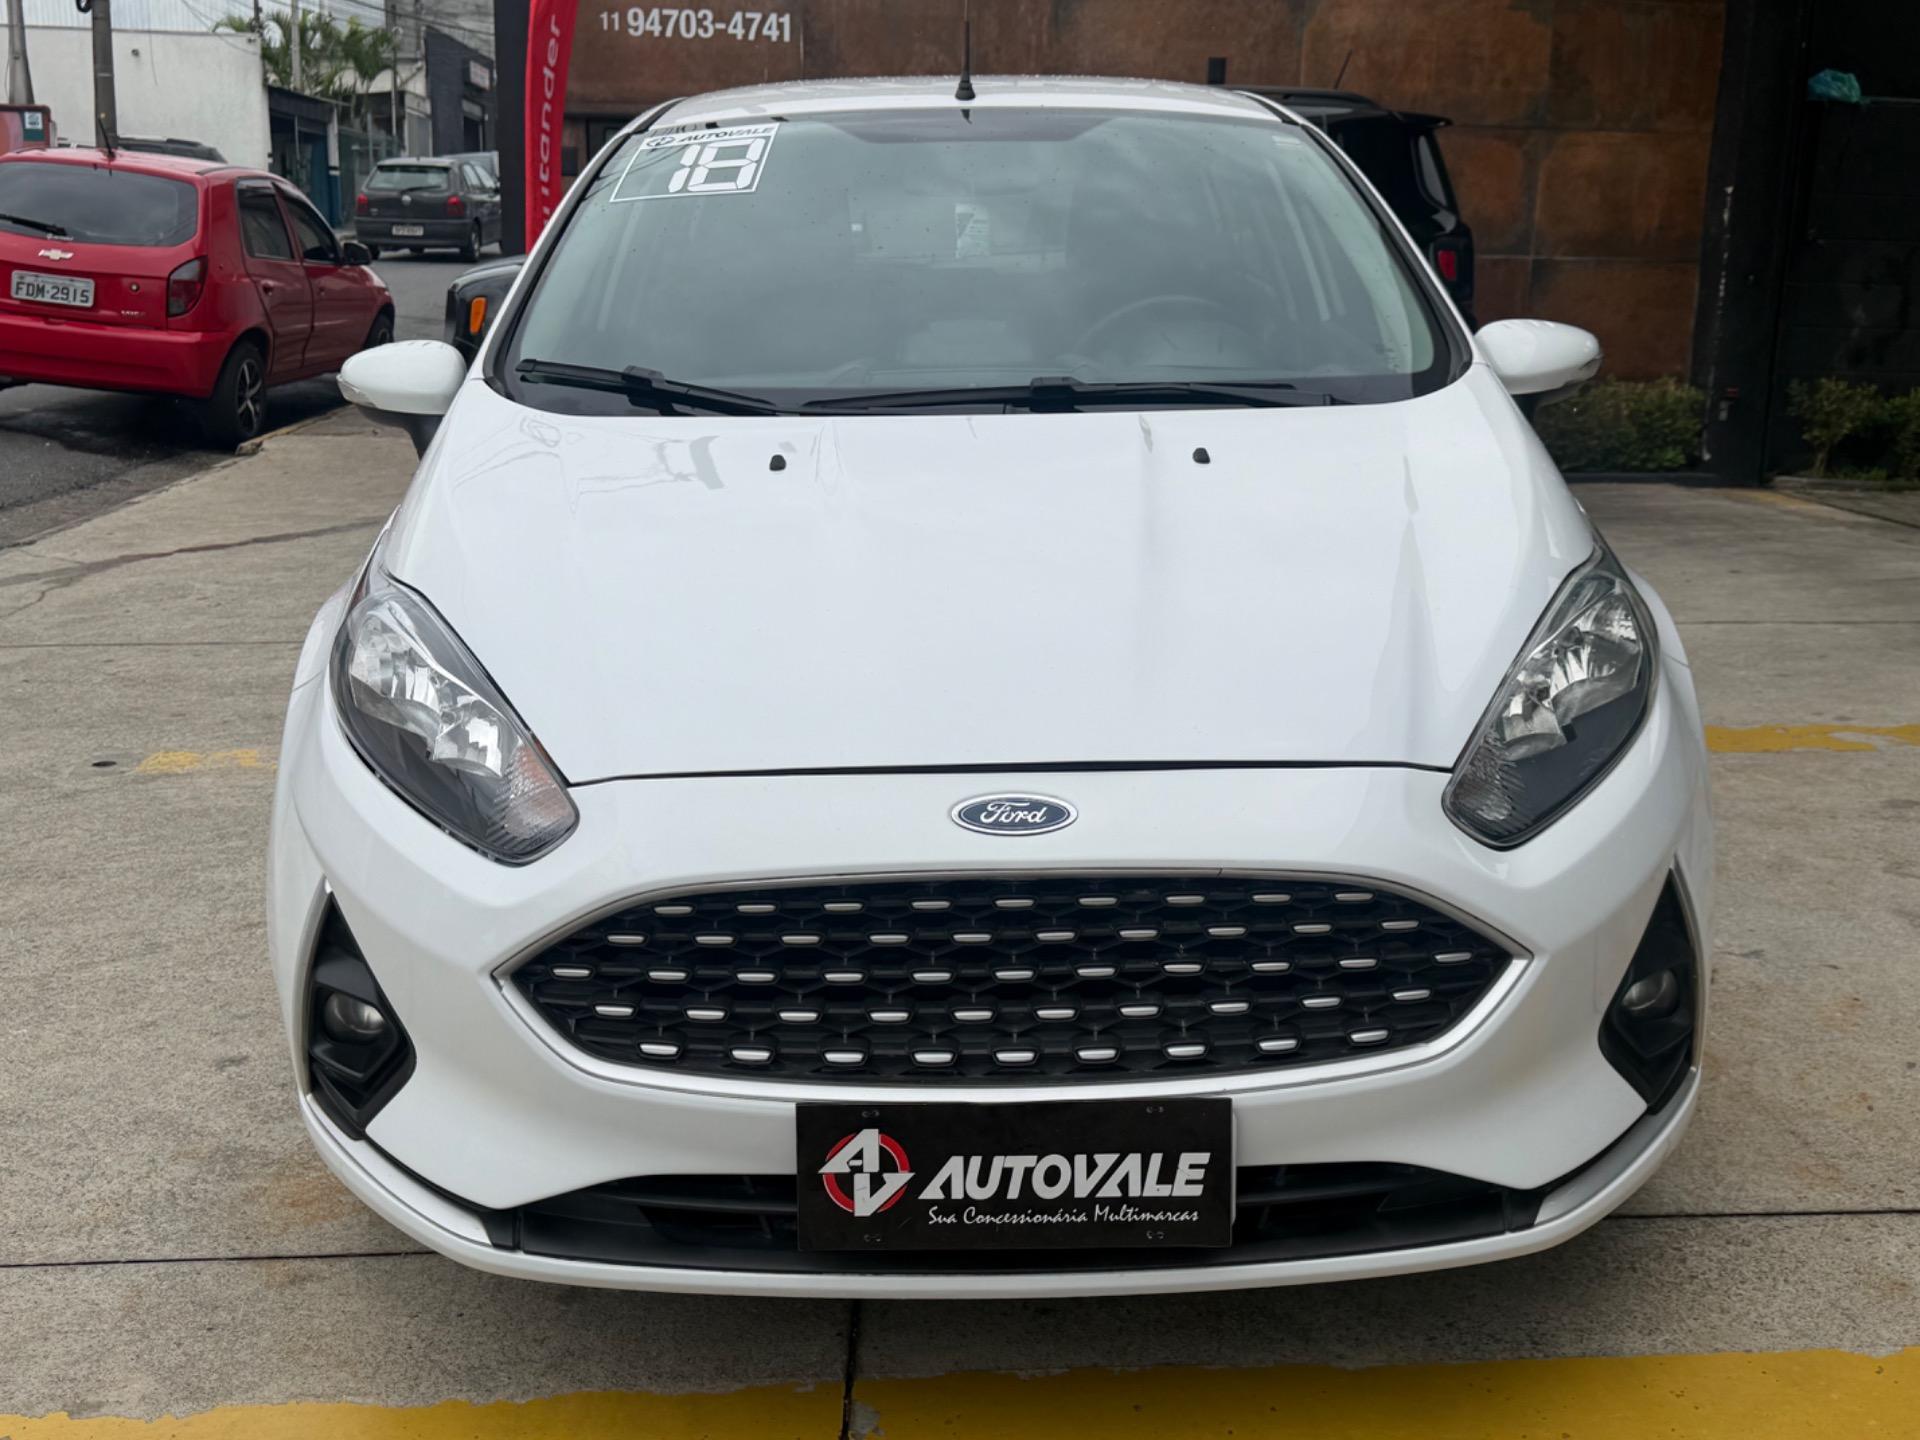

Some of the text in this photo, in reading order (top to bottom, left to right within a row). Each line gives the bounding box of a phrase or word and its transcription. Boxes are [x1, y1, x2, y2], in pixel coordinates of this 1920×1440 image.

[600, 7, 791, 42] 11 94703-4741
[678, 127, 775, 143] AUTOVALE
[668, 137, 766, 193] 18
[980, 801, 1048, 823] Ford
[918, 1152, 1211, 1200] AUTOVALE
[928, 1204, 1199, 1226] Sua Concessionária Multimarcas
